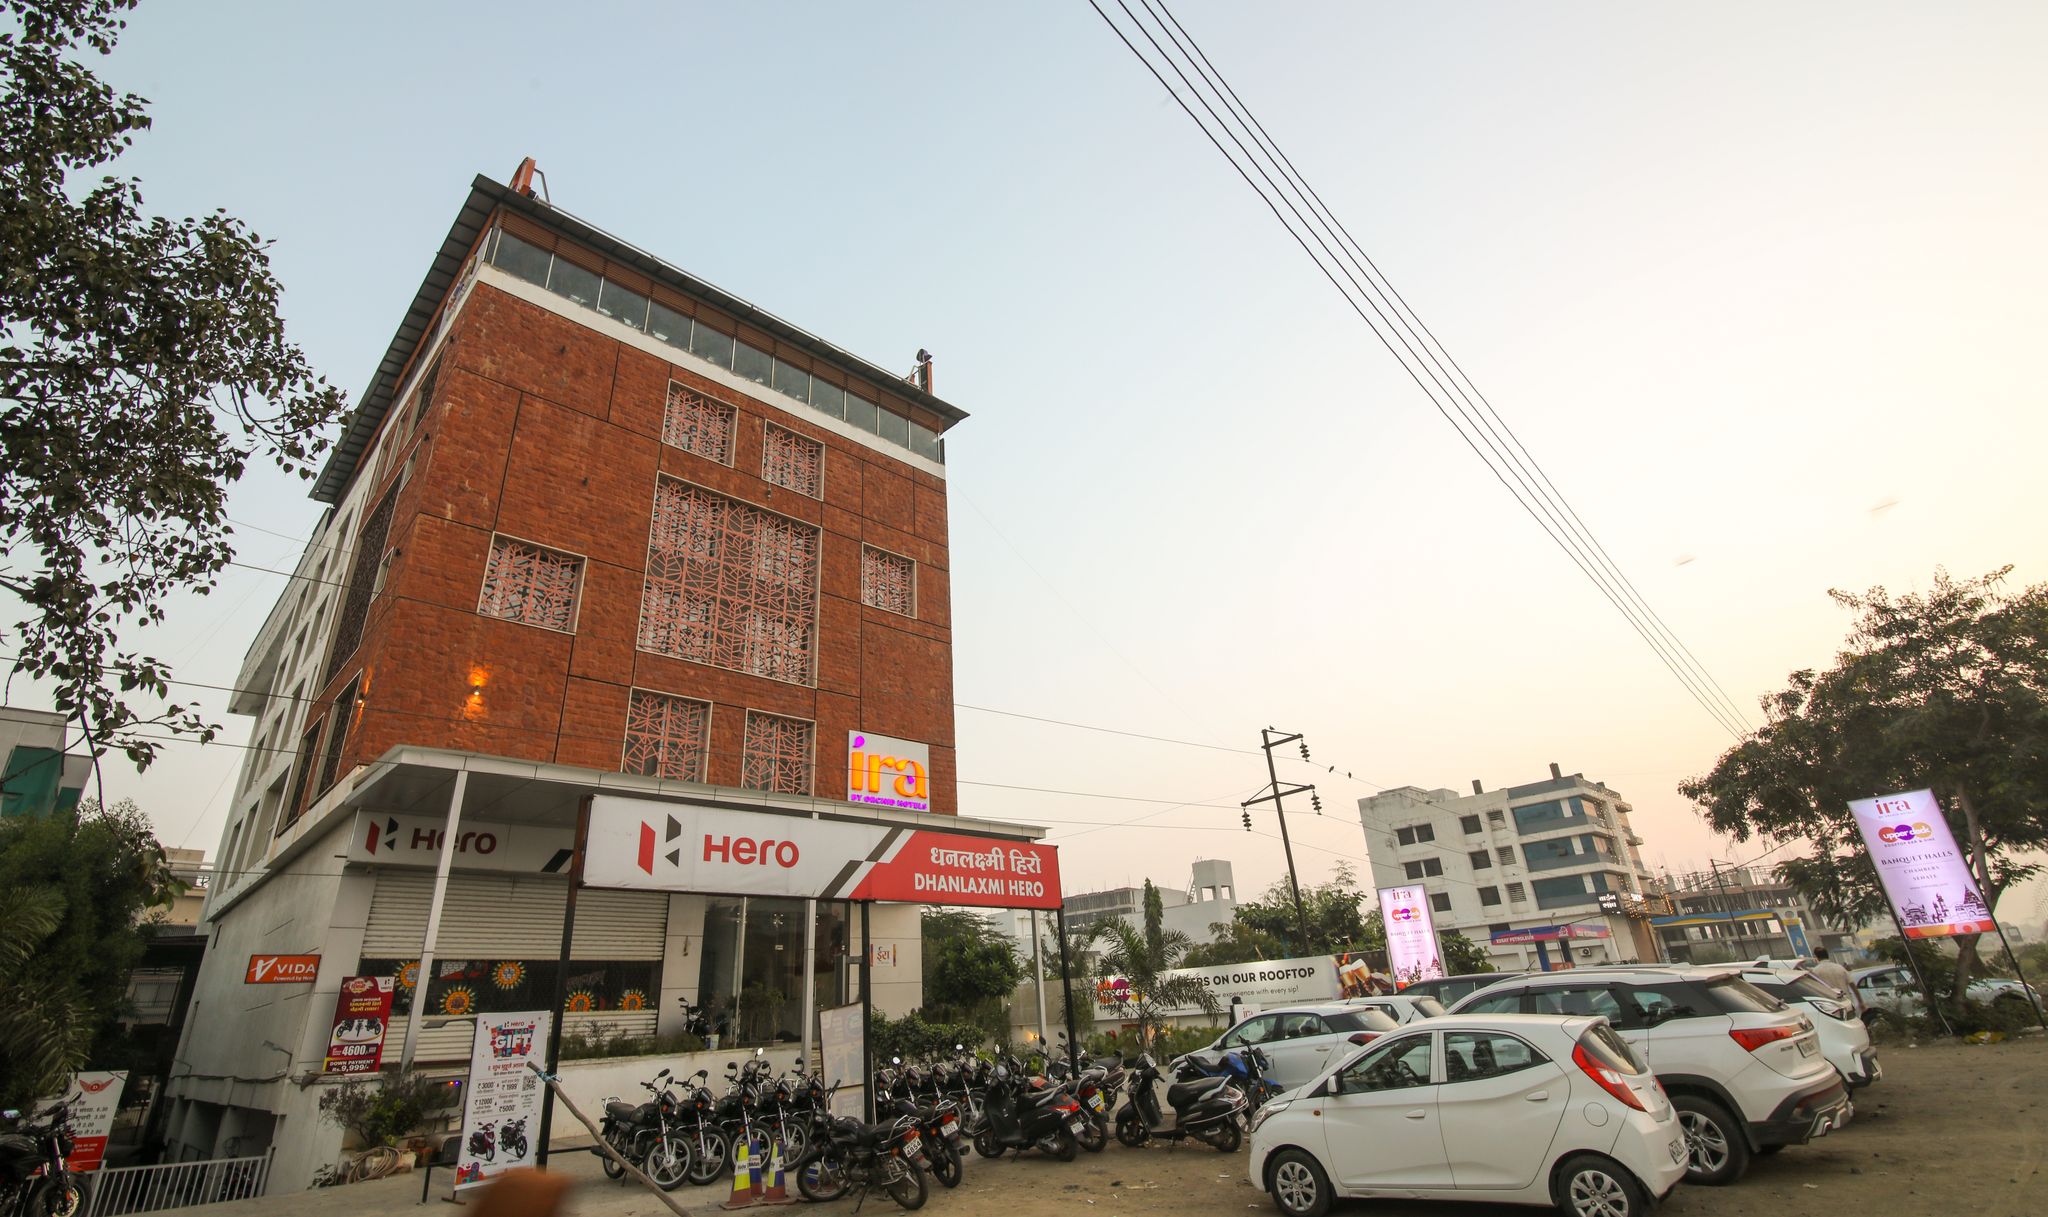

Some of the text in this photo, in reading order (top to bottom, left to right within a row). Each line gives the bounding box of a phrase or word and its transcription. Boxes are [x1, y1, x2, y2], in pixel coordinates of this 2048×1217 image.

[851, 735, 928, 799] ira
[851, 793, 928, 810] BY ORCHID HOTELS
[1875, 799, 1911, 815] ira
[1882, 830, 1909, 840] upper
[703, 834, 800, 868] Hero
[1881, 851, 1953, 865] BANQUET HALLS
[930, 847, 1042, 875] धनलक्ष्मी हिरो
[914, 873, 1044, 897] DHANLAXMI HERO
[1393, 889, 1411, 900] ira
[277, 963, 316, 974] VIDA
[1213, 975, 1229, 985] ON
[1232, 973, 1256, 984] OUR
[1259, 967, 1315, 982] ROOFTOP
[1270, 987, 1287, 995] every
[495, 1034, 530, 1049] GIFT
